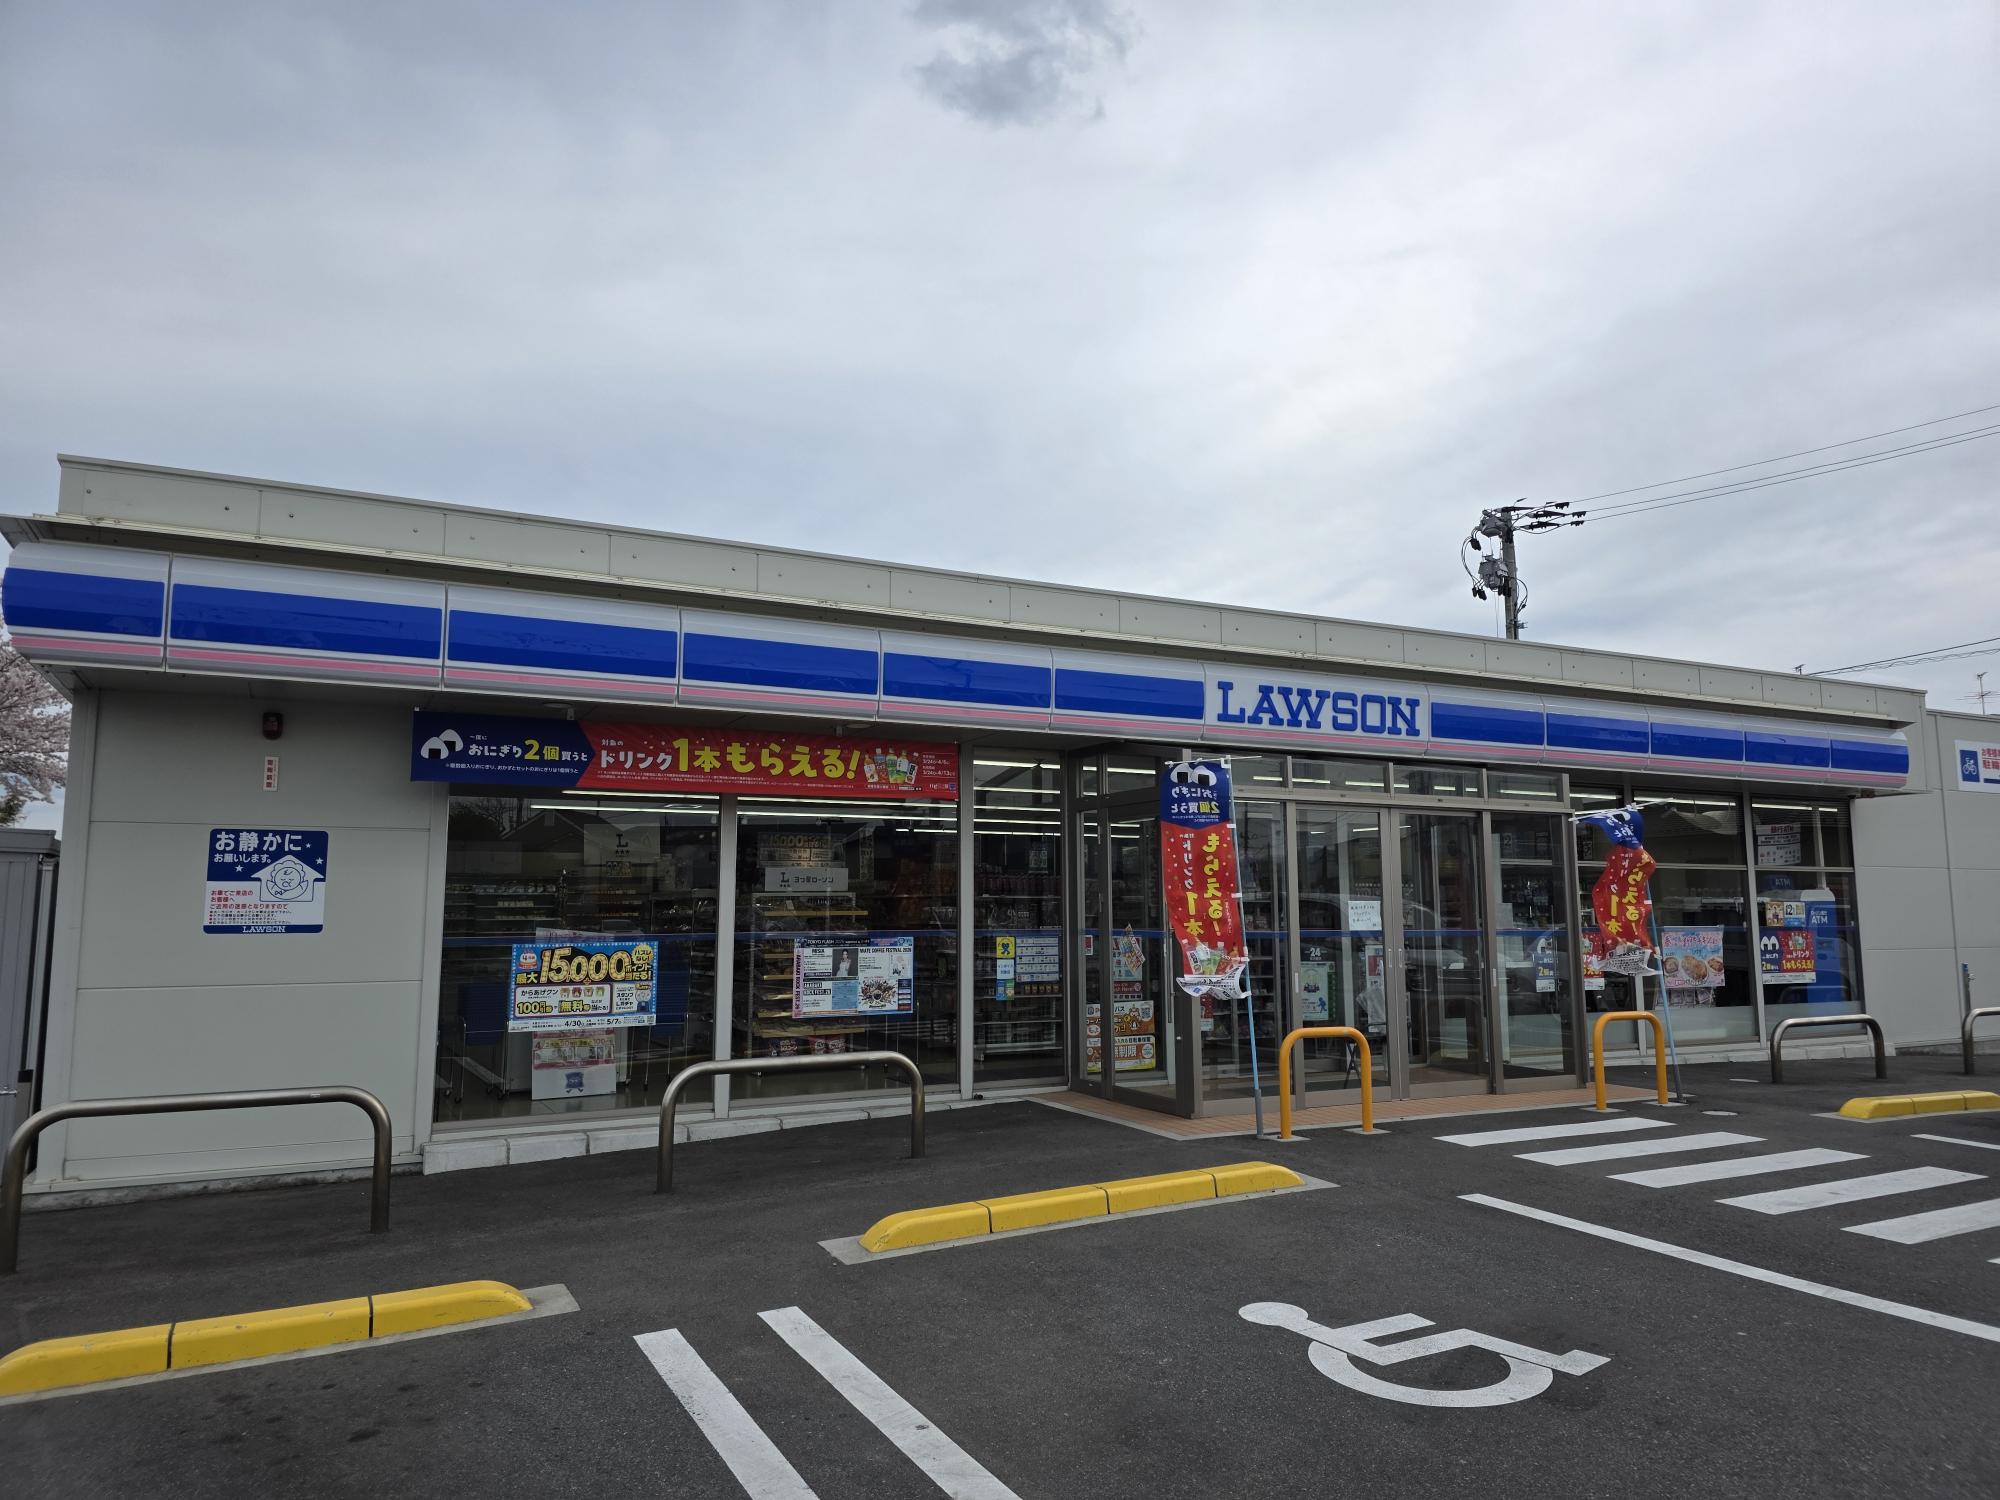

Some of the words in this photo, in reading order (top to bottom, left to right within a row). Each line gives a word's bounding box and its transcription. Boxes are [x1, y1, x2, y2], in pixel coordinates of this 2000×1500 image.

[1217, 680, 1421, 737] LAWSON
[468, 738, 588, 761] おにぎり2個買うと
[215, 831, 303, 852] お静かに
[213, 853, 272, 863] お願いします。
[1811, 915, 1829, 924] ATM
[242, 925, 286, 933] LAWSON
[516, 972, 539, 985] 最大
